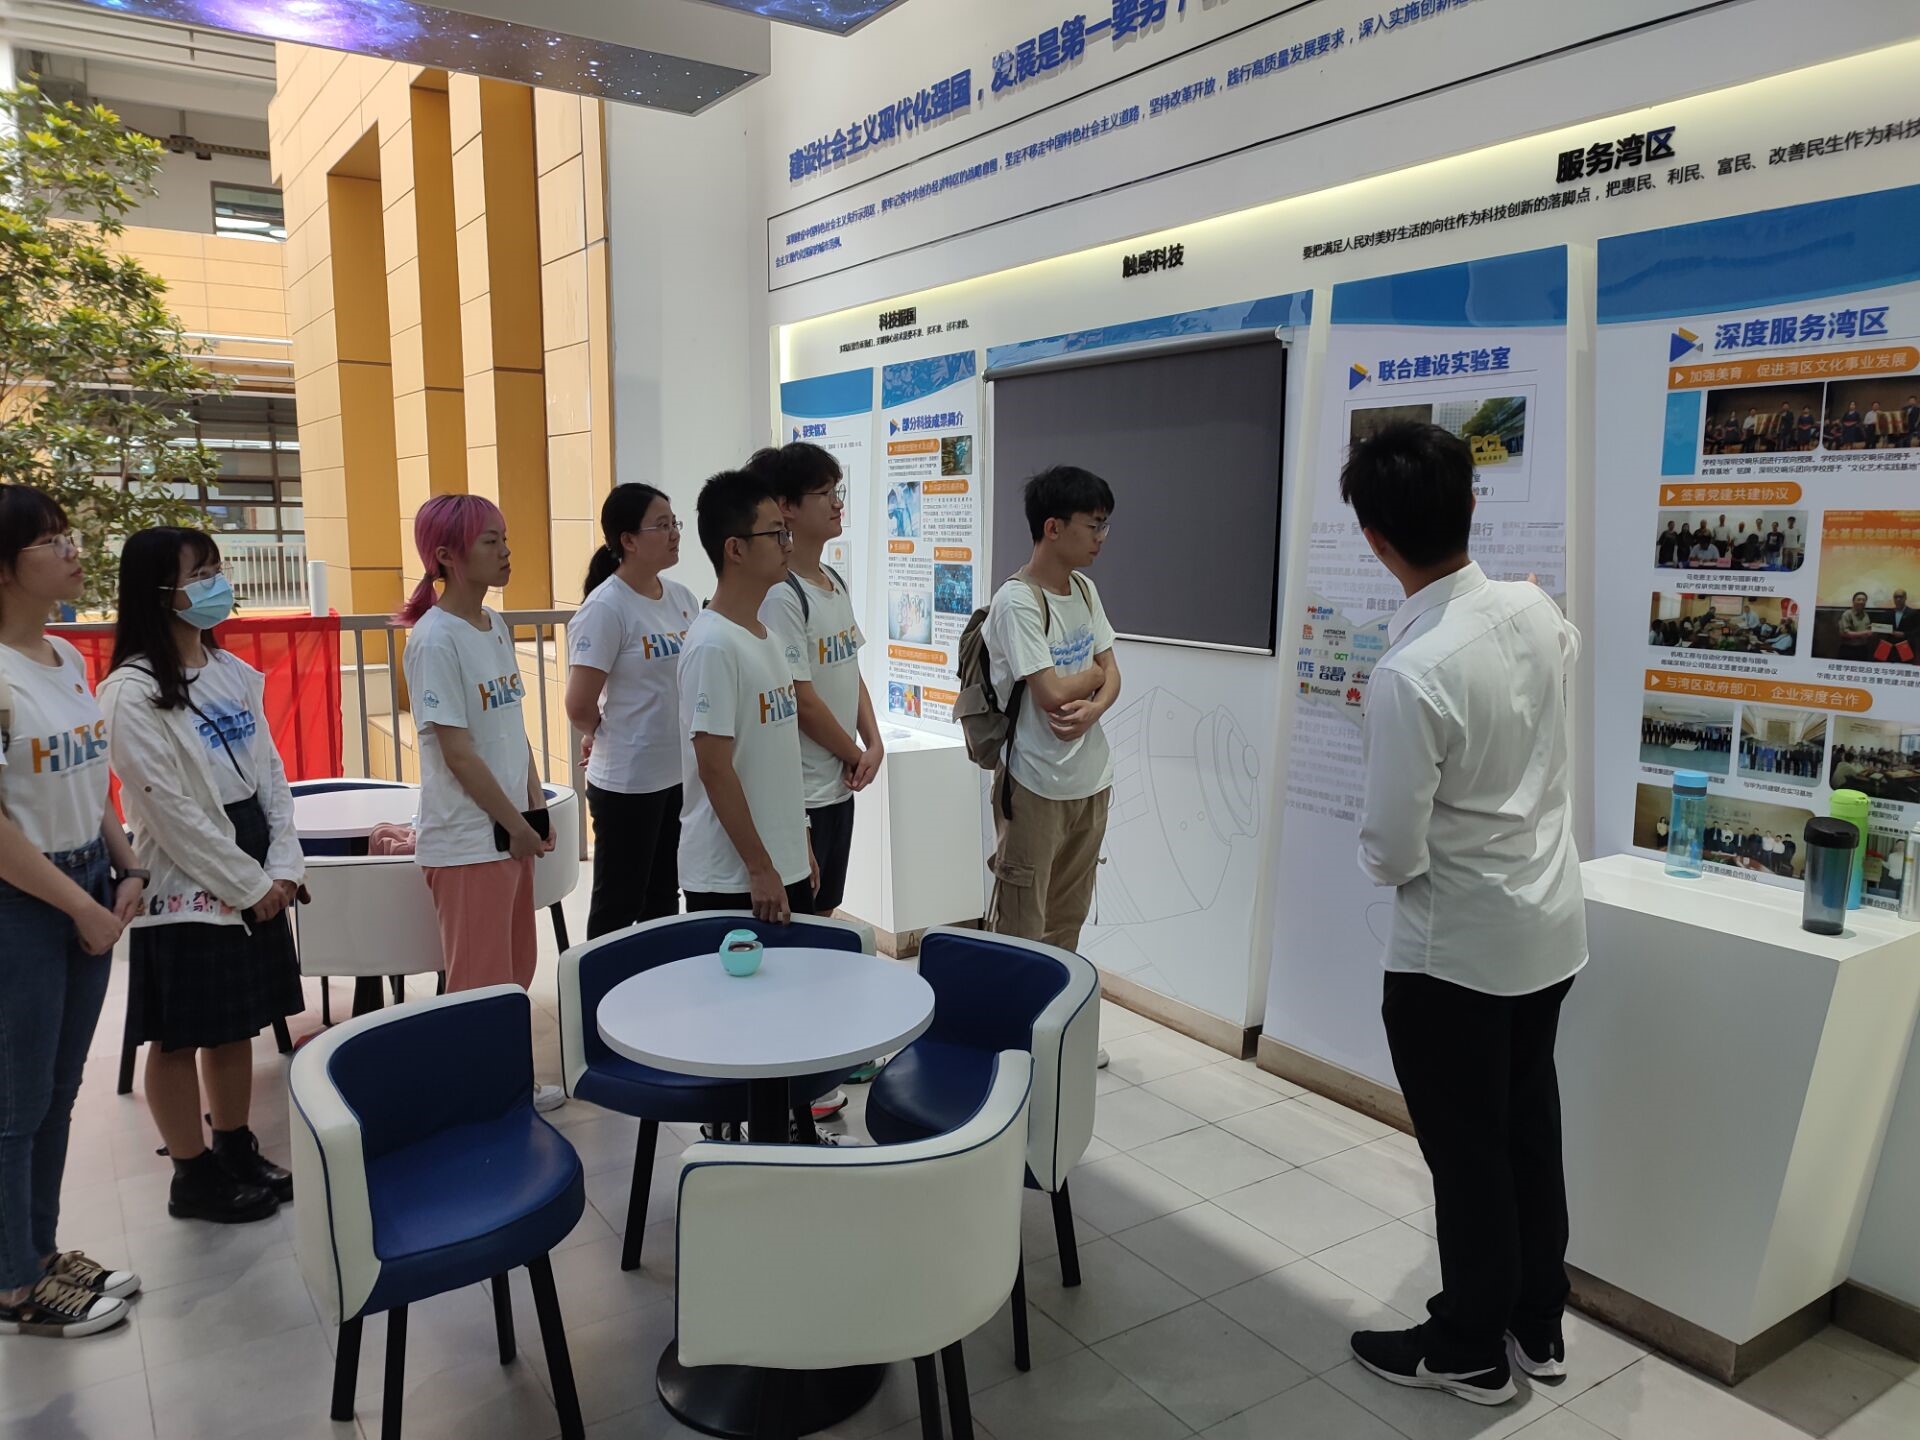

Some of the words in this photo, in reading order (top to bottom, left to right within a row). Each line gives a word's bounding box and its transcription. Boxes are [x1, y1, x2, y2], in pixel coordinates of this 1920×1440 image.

[1555, 126, 1676, 184] 服务湾区
[1122, 243, 1184, 278] 触感科技
[878, 307, 917, 331] 科技报国
[1714, 306, 1890, 350] 深度服务湾区
[1378, 346, 1511, 382] 联合建设实验室
[1689, 352, 1907, 384] 加强美育，促进湾区文化事业发展
[902, 412, 964, 432] 部分科技成果简介
[1681, 486, 1789, 501] 签署党建共建协议
[1310, 683, 1342, 698] Microsoft
[1665, 676, 1861, 706] 与湾区政府部门、企业深度合作
